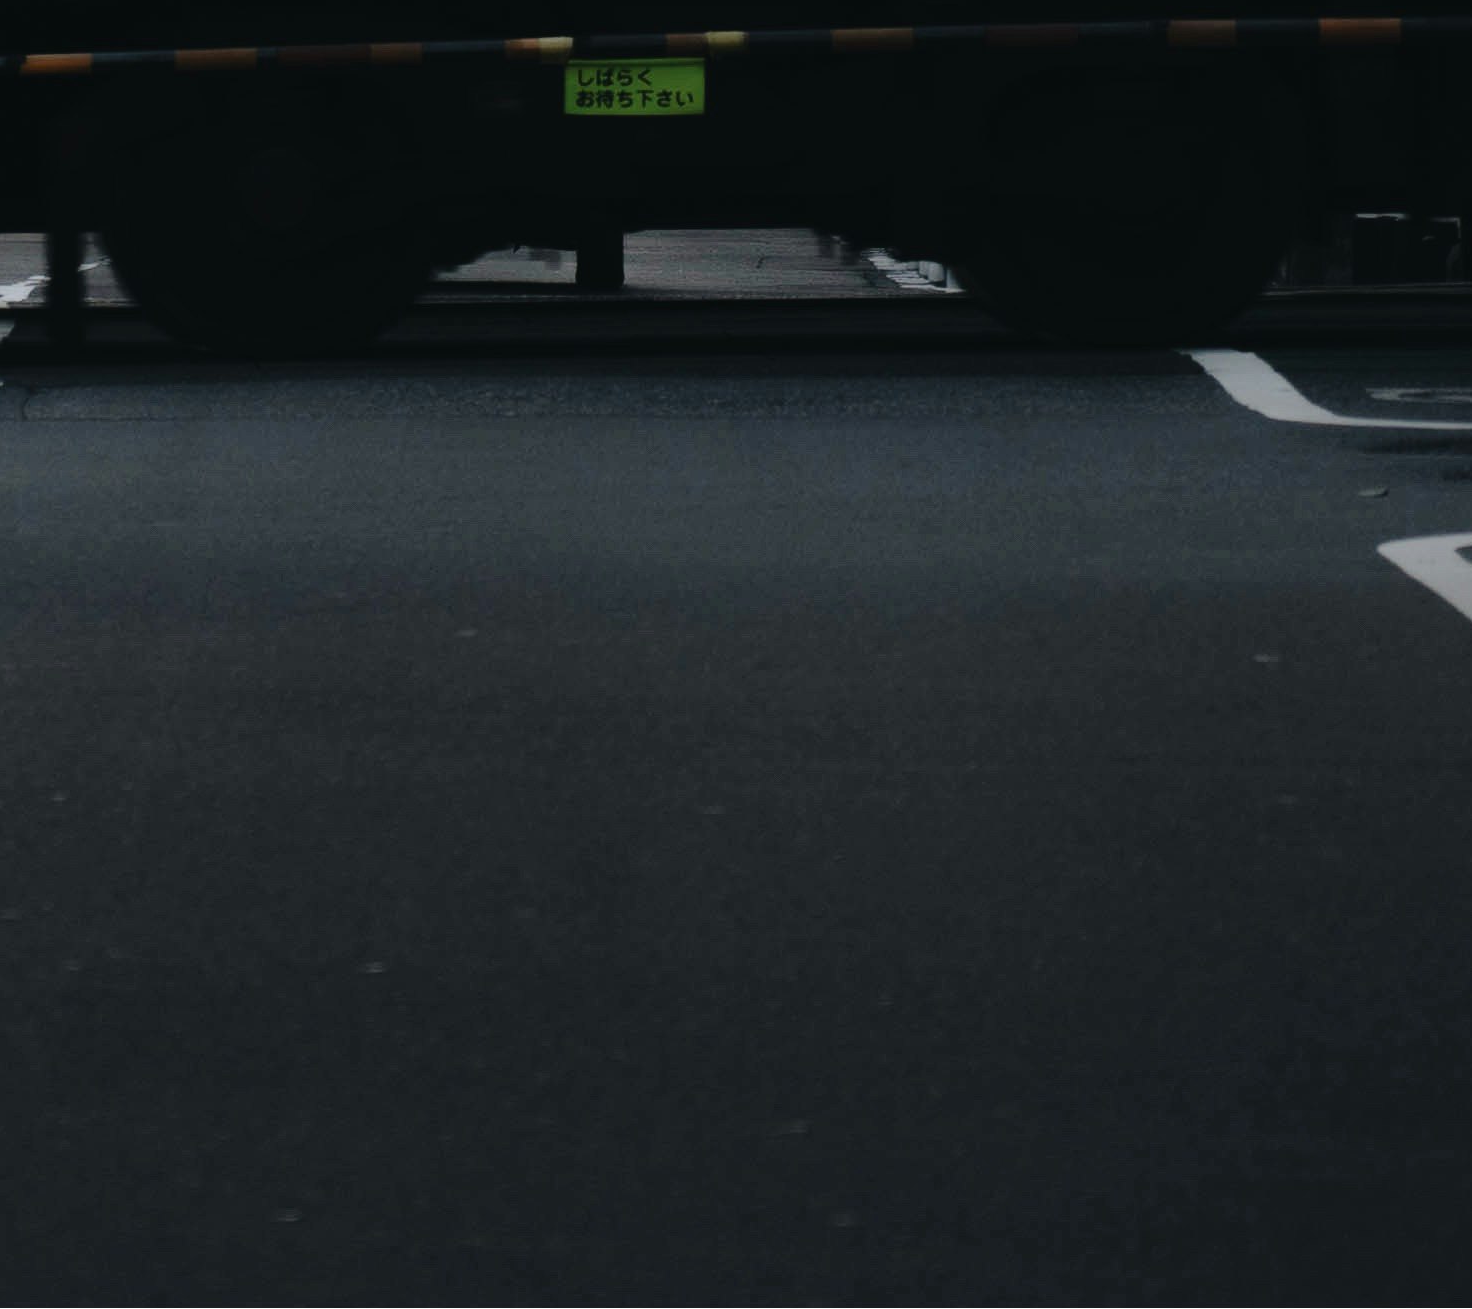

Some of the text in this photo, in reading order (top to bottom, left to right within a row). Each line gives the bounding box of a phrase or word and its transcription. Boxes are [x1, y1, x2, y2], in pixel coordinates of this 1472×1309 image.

[577, 68, 654, 87] しばらく
[575, 88, 695, 109] お待ち下さい
